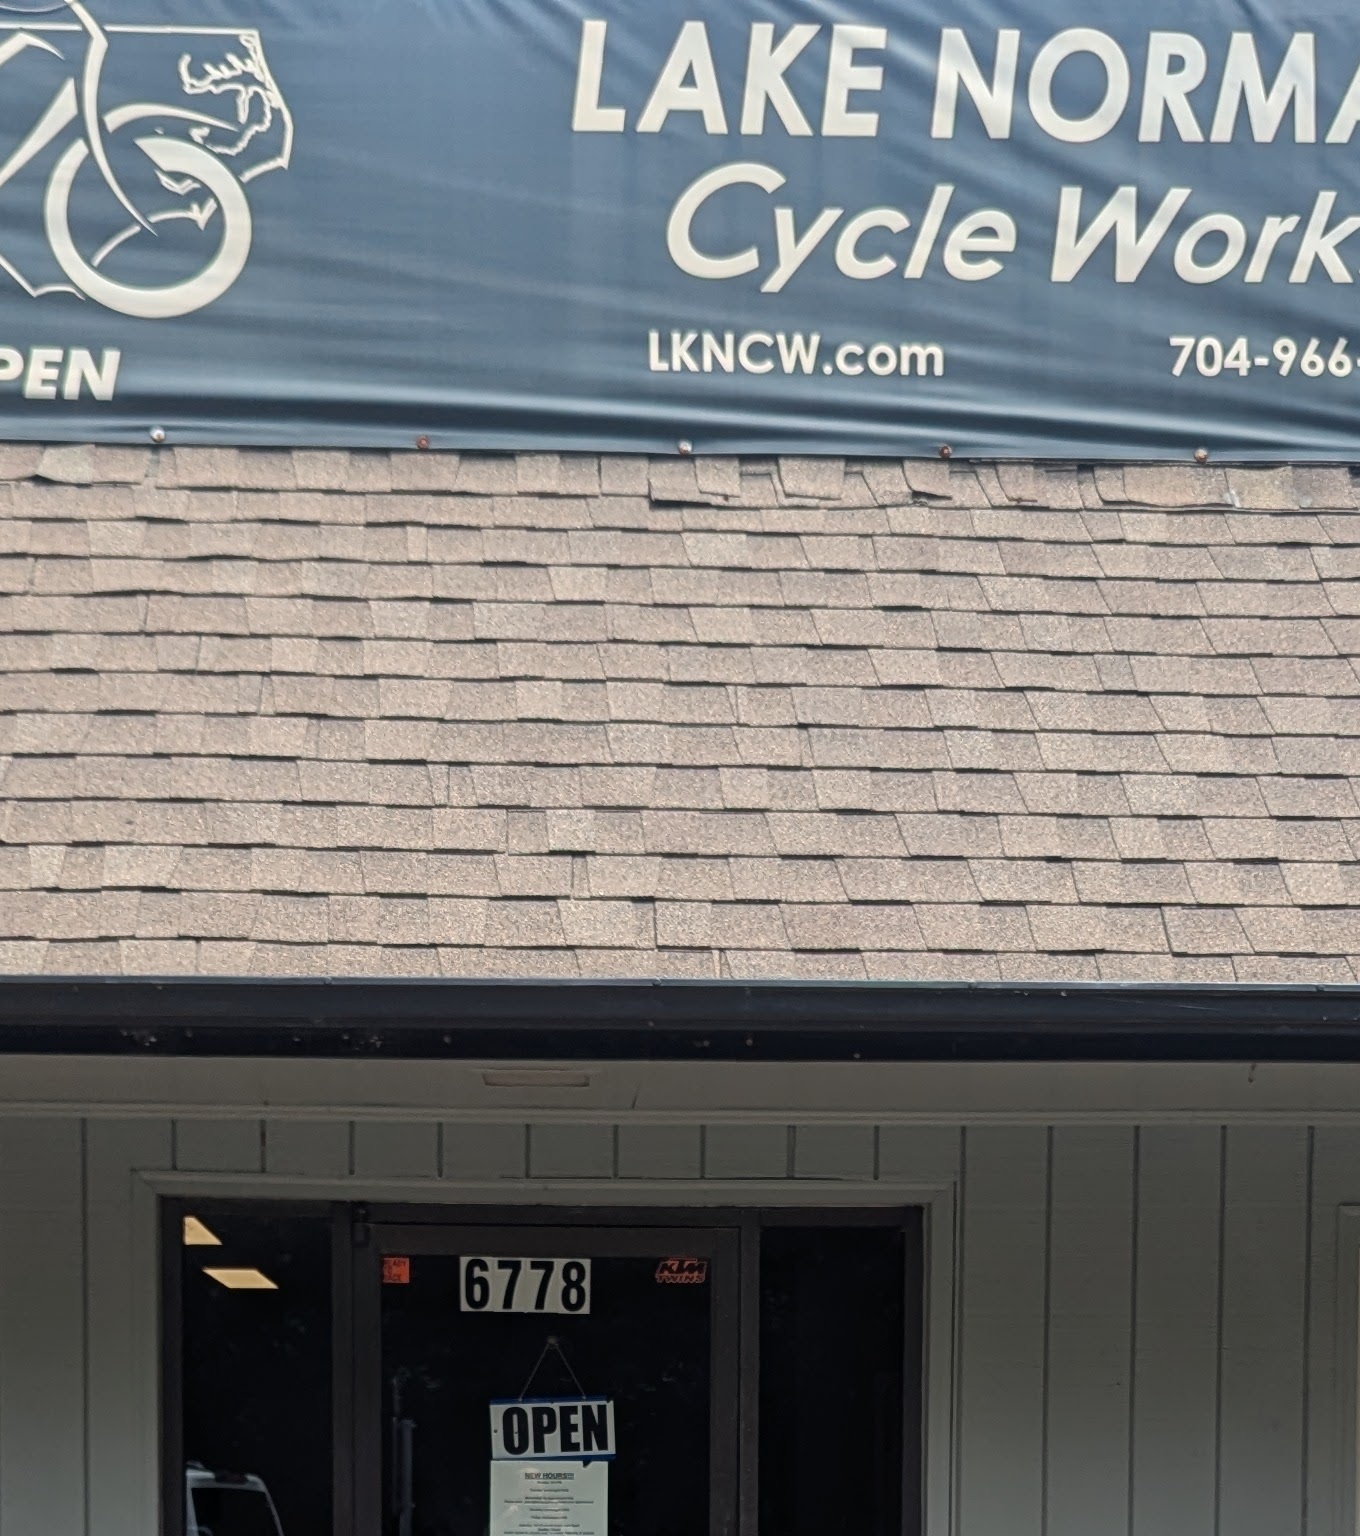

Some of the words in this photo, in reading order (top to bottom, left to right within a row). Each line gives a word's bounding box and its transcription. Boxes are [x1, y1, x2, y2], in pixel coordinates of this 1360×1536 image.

[571, 20, 887, 138] LAKE
[666, 162, 1017, 293] Cycle
[648, 332, 944, 377] LKNCW.com
[464, 1259, 586, 1312] 6778
[657, 1258, 706, 1274] KTM
[502, 1404, 609, 1456] OPEN
